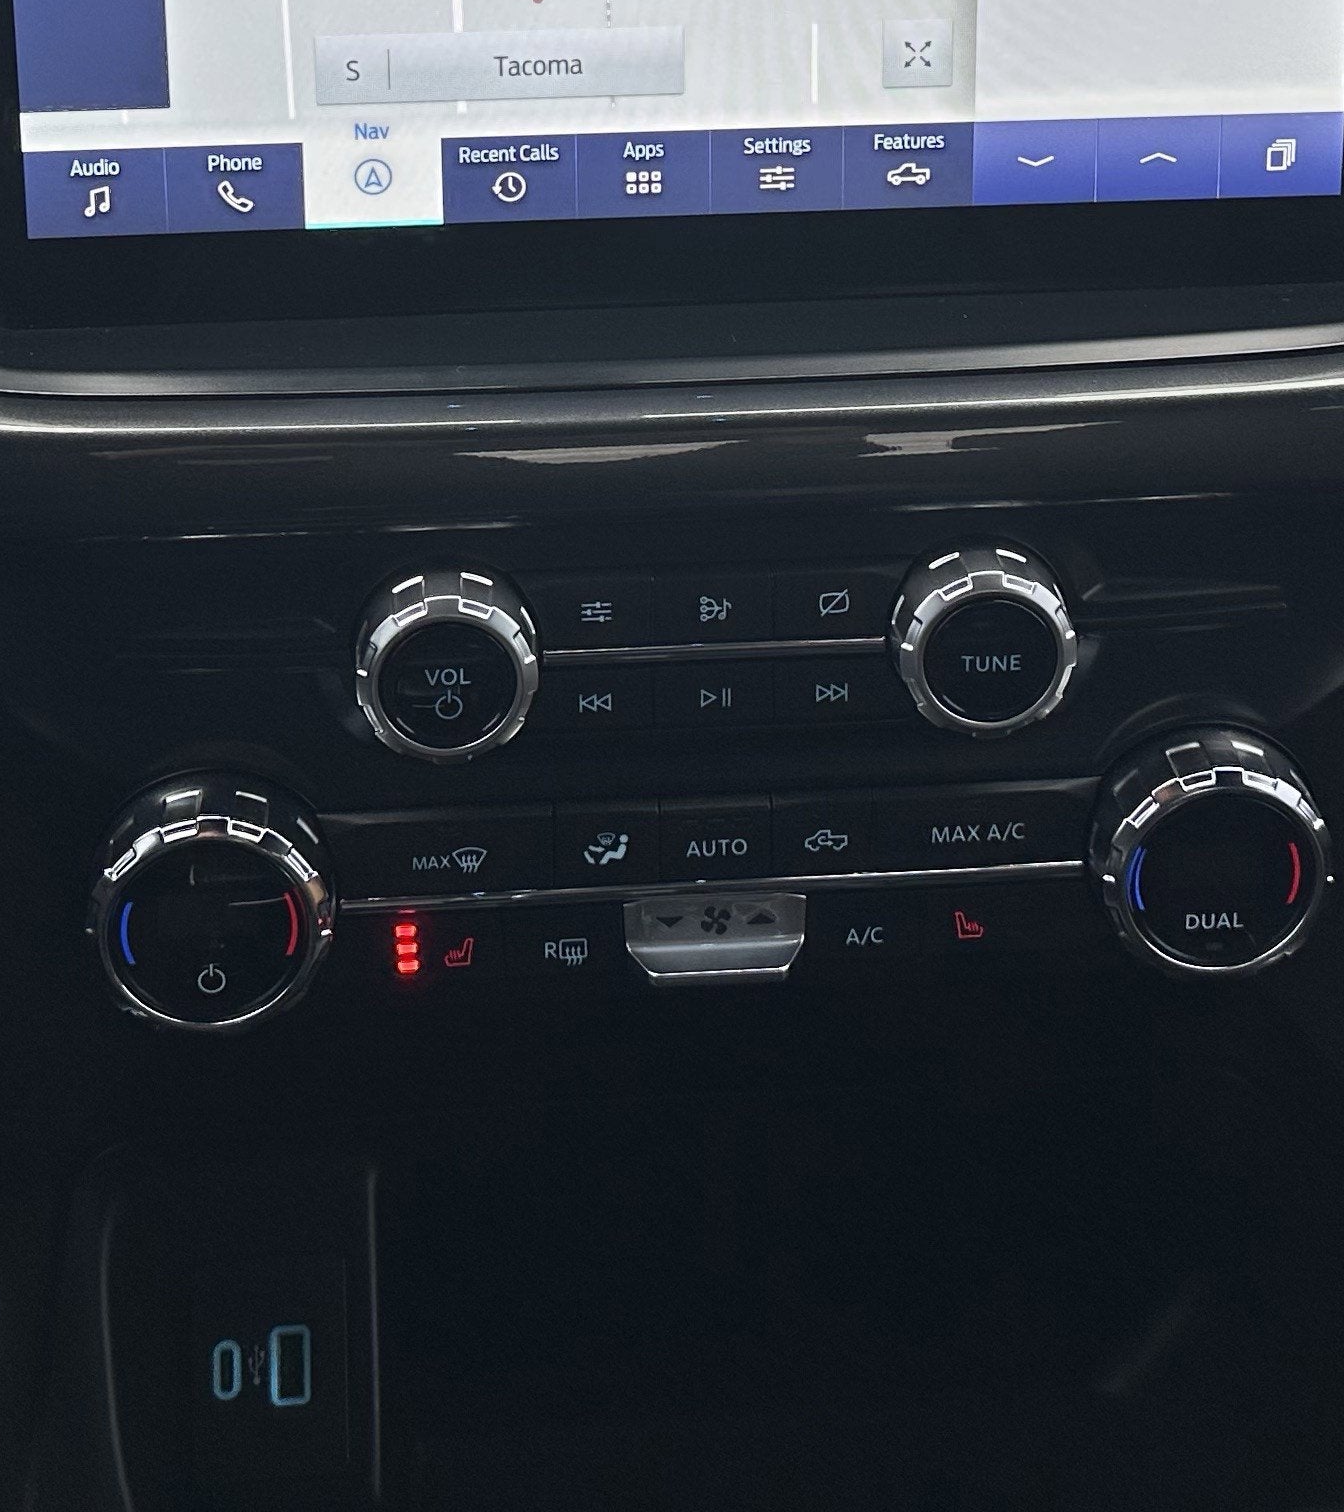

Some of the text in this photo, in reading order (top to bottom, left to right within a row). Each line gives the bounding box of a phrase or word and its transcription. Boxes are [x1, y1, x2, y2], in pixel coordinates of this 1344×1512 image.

[346, 60, 360, 81] S
[494, 56, 582, 76] Tacoma
[355, 123, 389, 139] Nav
[623, 142, 664, 160] Apps
[744, 137, 810, 155] Settings
[874, 134, 944, 150] Features
[459, 144, 559, 163] Recent Calls
[71, 159, 119, 177] Audio
[208, 155, 262, 171] Phone
[962, 655, 1020, 672] TUNE
[425, 668, 471, 685] VOL
[932, 823, 1024, 843] MAX A/C
[687, 839, 747, 857] AUTO
[413, 856, 450, 869] MAX
[1186, 913, 1243, 929] DUAL
[846, 927, 882, 945] A/C
[545, 942, 556, 958] R
